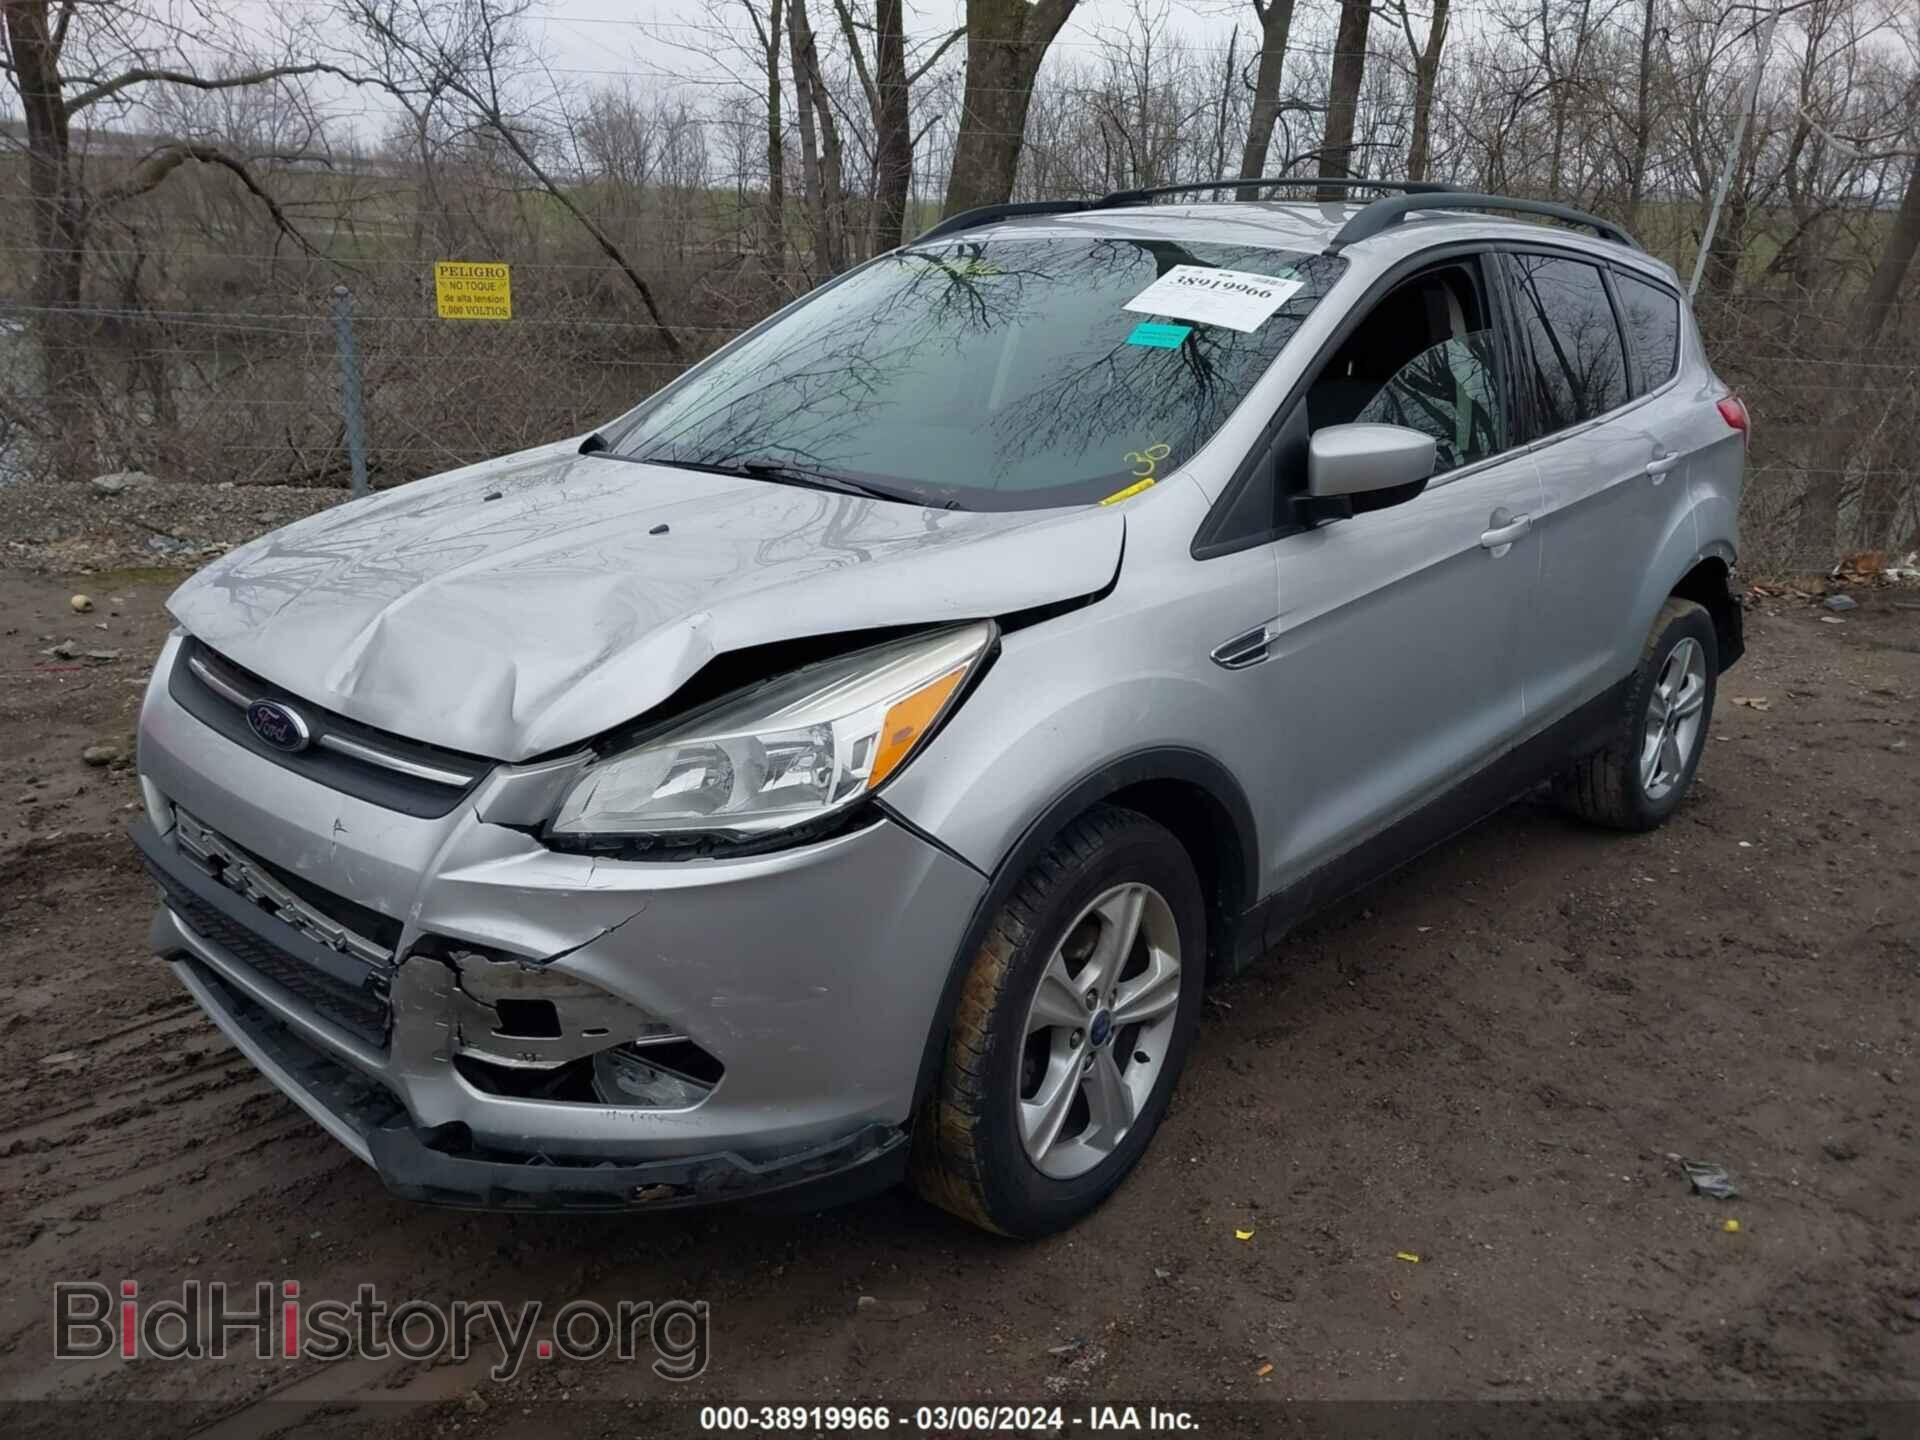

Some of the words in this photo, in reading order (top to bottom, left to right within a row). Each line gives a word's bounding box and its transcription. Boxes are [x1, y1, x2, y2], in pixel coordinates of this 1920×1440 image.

[439, 265, 506, 278] PELIGRO
[449, 281, 463, 291] NO
[465, 281, 497, 292] TOQUE
[1168, 275, 1273, 299] 38919966
[457, 295, 472, 303] alta
[466, 304, 509, 317] VOLTIOS
[255, 706, 290, 742] Ford
